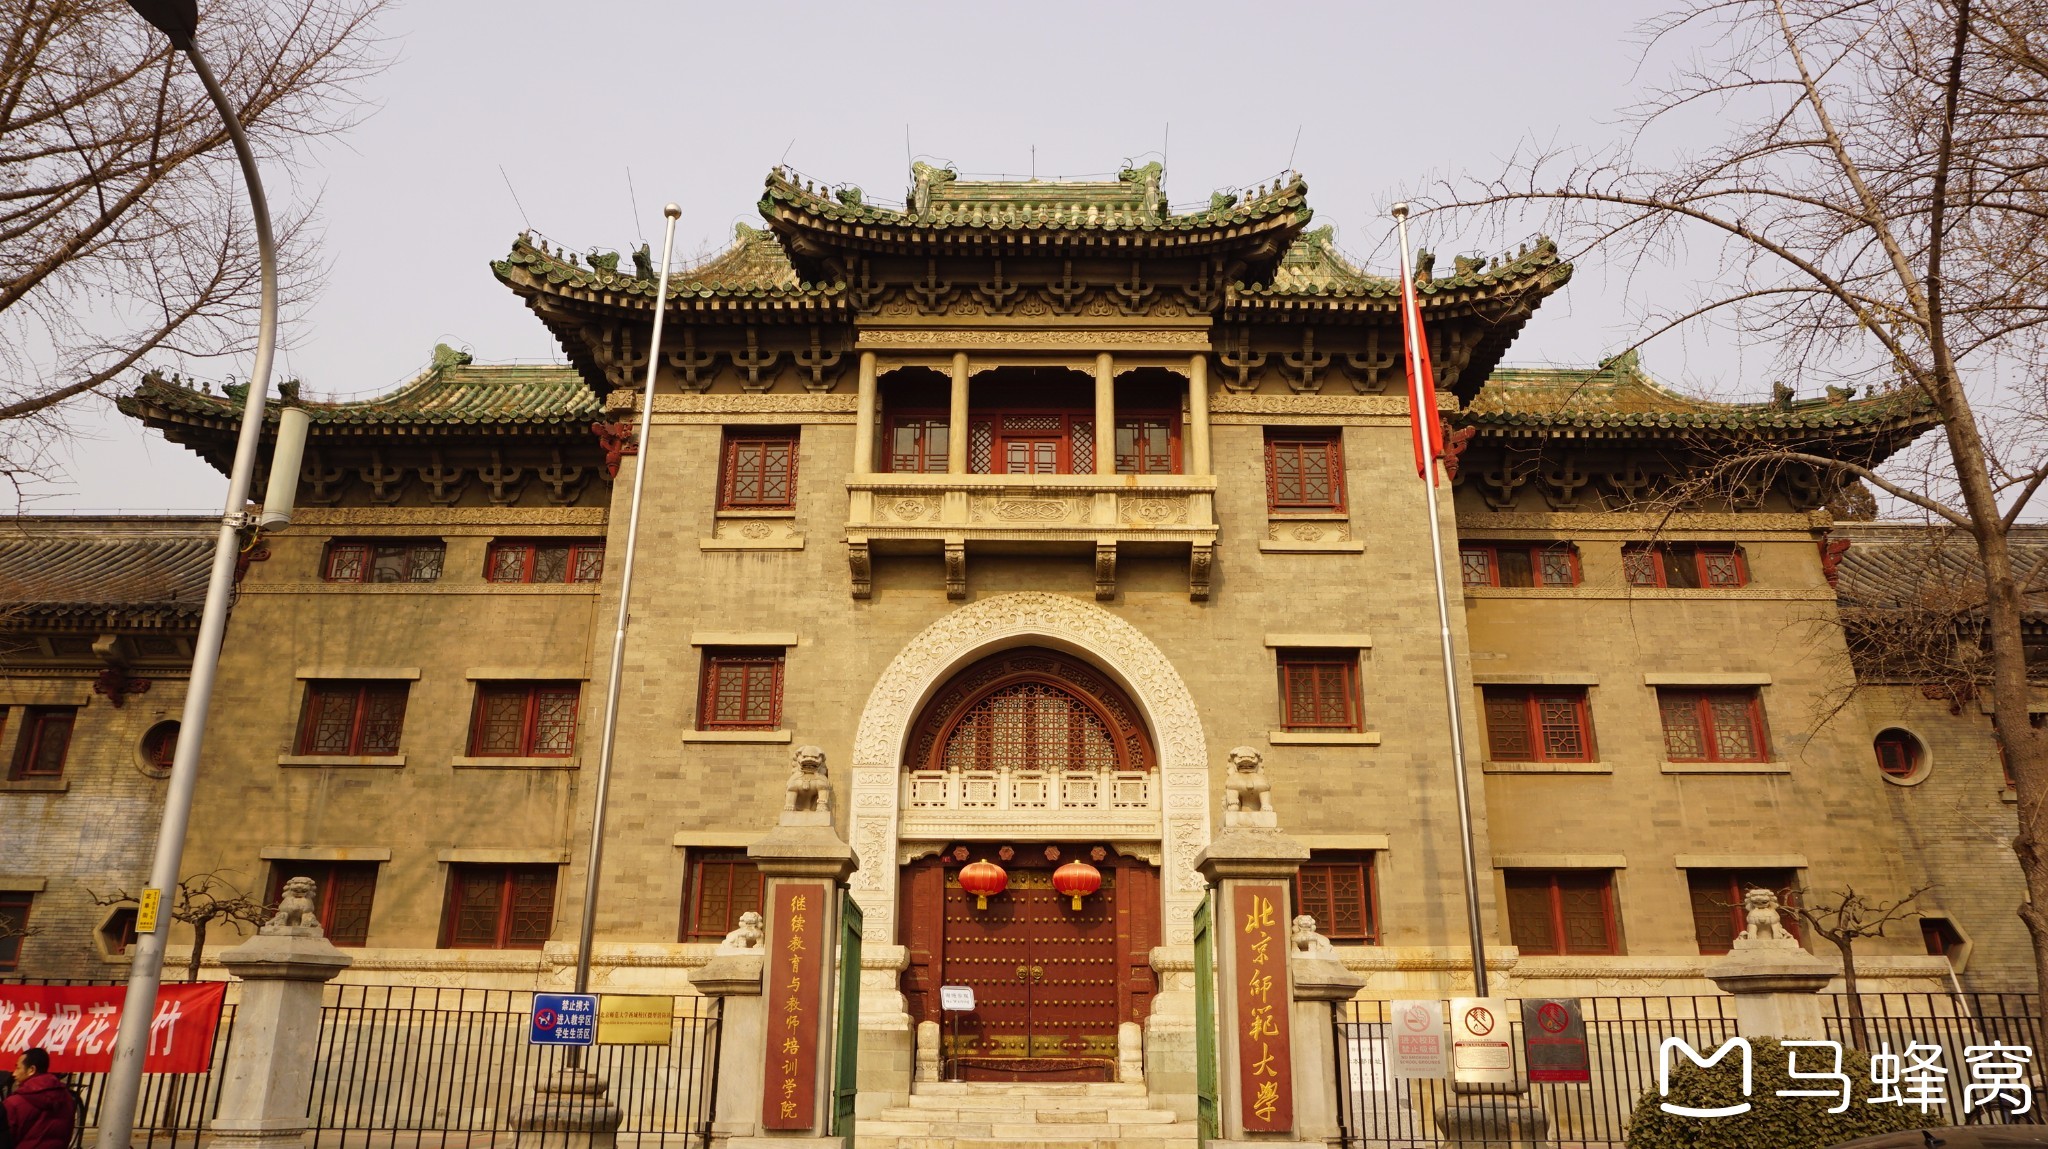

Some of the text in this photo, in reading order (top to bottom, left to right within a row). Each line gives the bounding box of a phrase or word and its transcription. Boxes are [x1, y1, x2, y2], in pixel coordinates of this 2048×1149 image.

[561, 1000, 590, 1011] 禁止携犬
[780, 894, 807, 1120] 继续教育与教师培训学院
[556, 1014, 592, 1025] 进入教学区
[0, 1000, 182, 1057] 放烟花竹
[555, 1027, 591, 1039] 学生生活区
